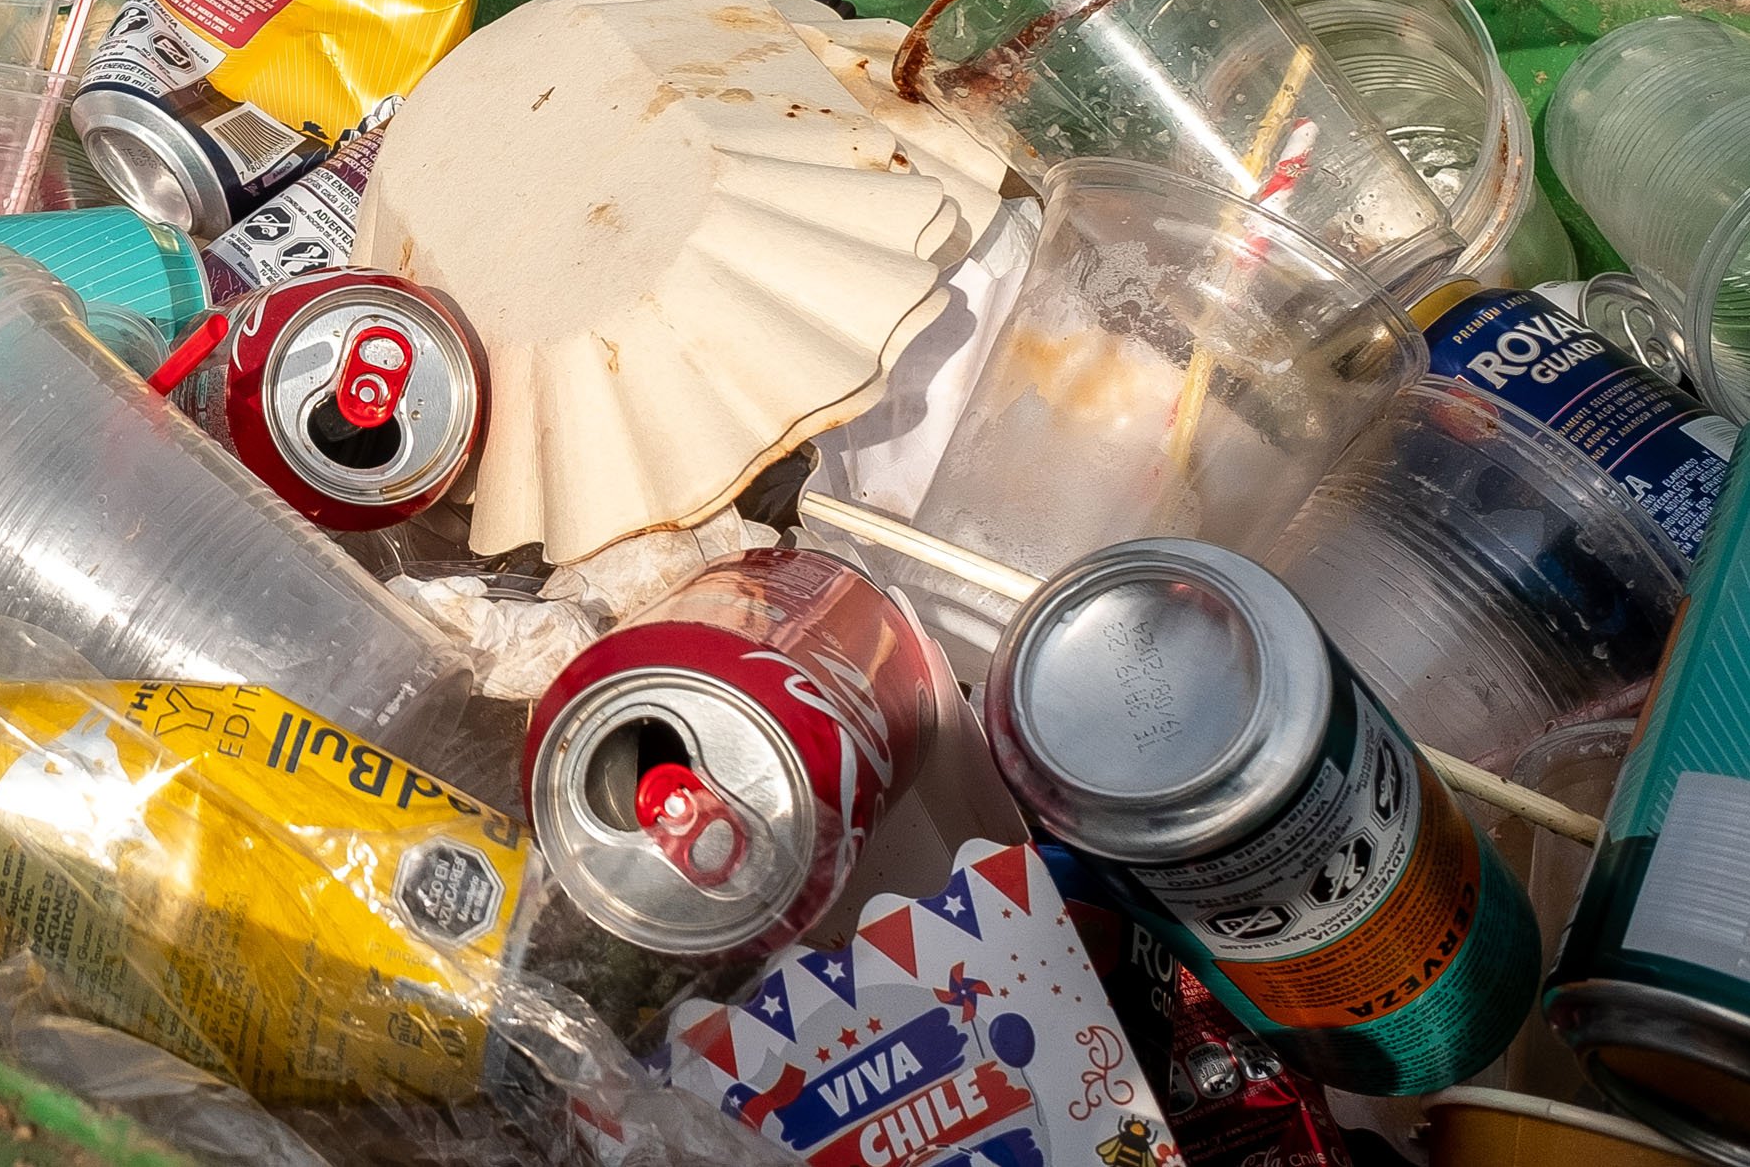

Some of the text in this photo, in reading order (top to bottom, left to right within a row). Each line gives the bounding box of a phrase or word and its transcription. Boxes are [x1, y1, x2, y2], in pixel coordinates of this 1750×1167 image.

[102, 61, 158, 83] ENERGÉTICO
[114, 73, 132, 82] 100
[132, 78, 146, 88] ml
[321, 187, 353, 217] cada 100
[313, 208, 354, 248] ADVERTEN
[1451, 306, 1502, 345] PREMIUM
[1466, 311, 1595, 390] ROYAL
[1530, 338, 1606, 384] GUARD
[1569, 419, 1597, 443] GUARD
[1595, 404, 1616, 422] ALGO
[1582, 424, 1611, 450] AROMA
[1615, 410, 1625, 422] EL
[1607, 436, 1620, 448] EL
[1617, 410, 1652, 438] AMARGOR
[1661, 457, 1699, 488] ELABORADO
[1683, 464, 1704, 482] CHILE
[1663, 485, 1695, 515] INDICADA
[265, 710, 396, 798] Bull
[1165, 798, 1331, 889] VALOR ENERGÉTICO
[1233, 832, 1277, 862] cada
[434, 858, 451, 881] EN
[1193, 859, 1228, 875] 100
[1366, 874, 1380, 889] DE
[1307, 840, 1407, 942] ADVERTENCIA
[1317, 884, 1368, 930] ALCOHOL
[1272, 936, 1289, 949] TU
[1345, 883, 1477, 1019] CERVEZA
[817, 1040, 924, 1118] VIVA
[859, 1067, 989, 1167] CHILE
[1289, 1151, 1327, 1167] Chile
